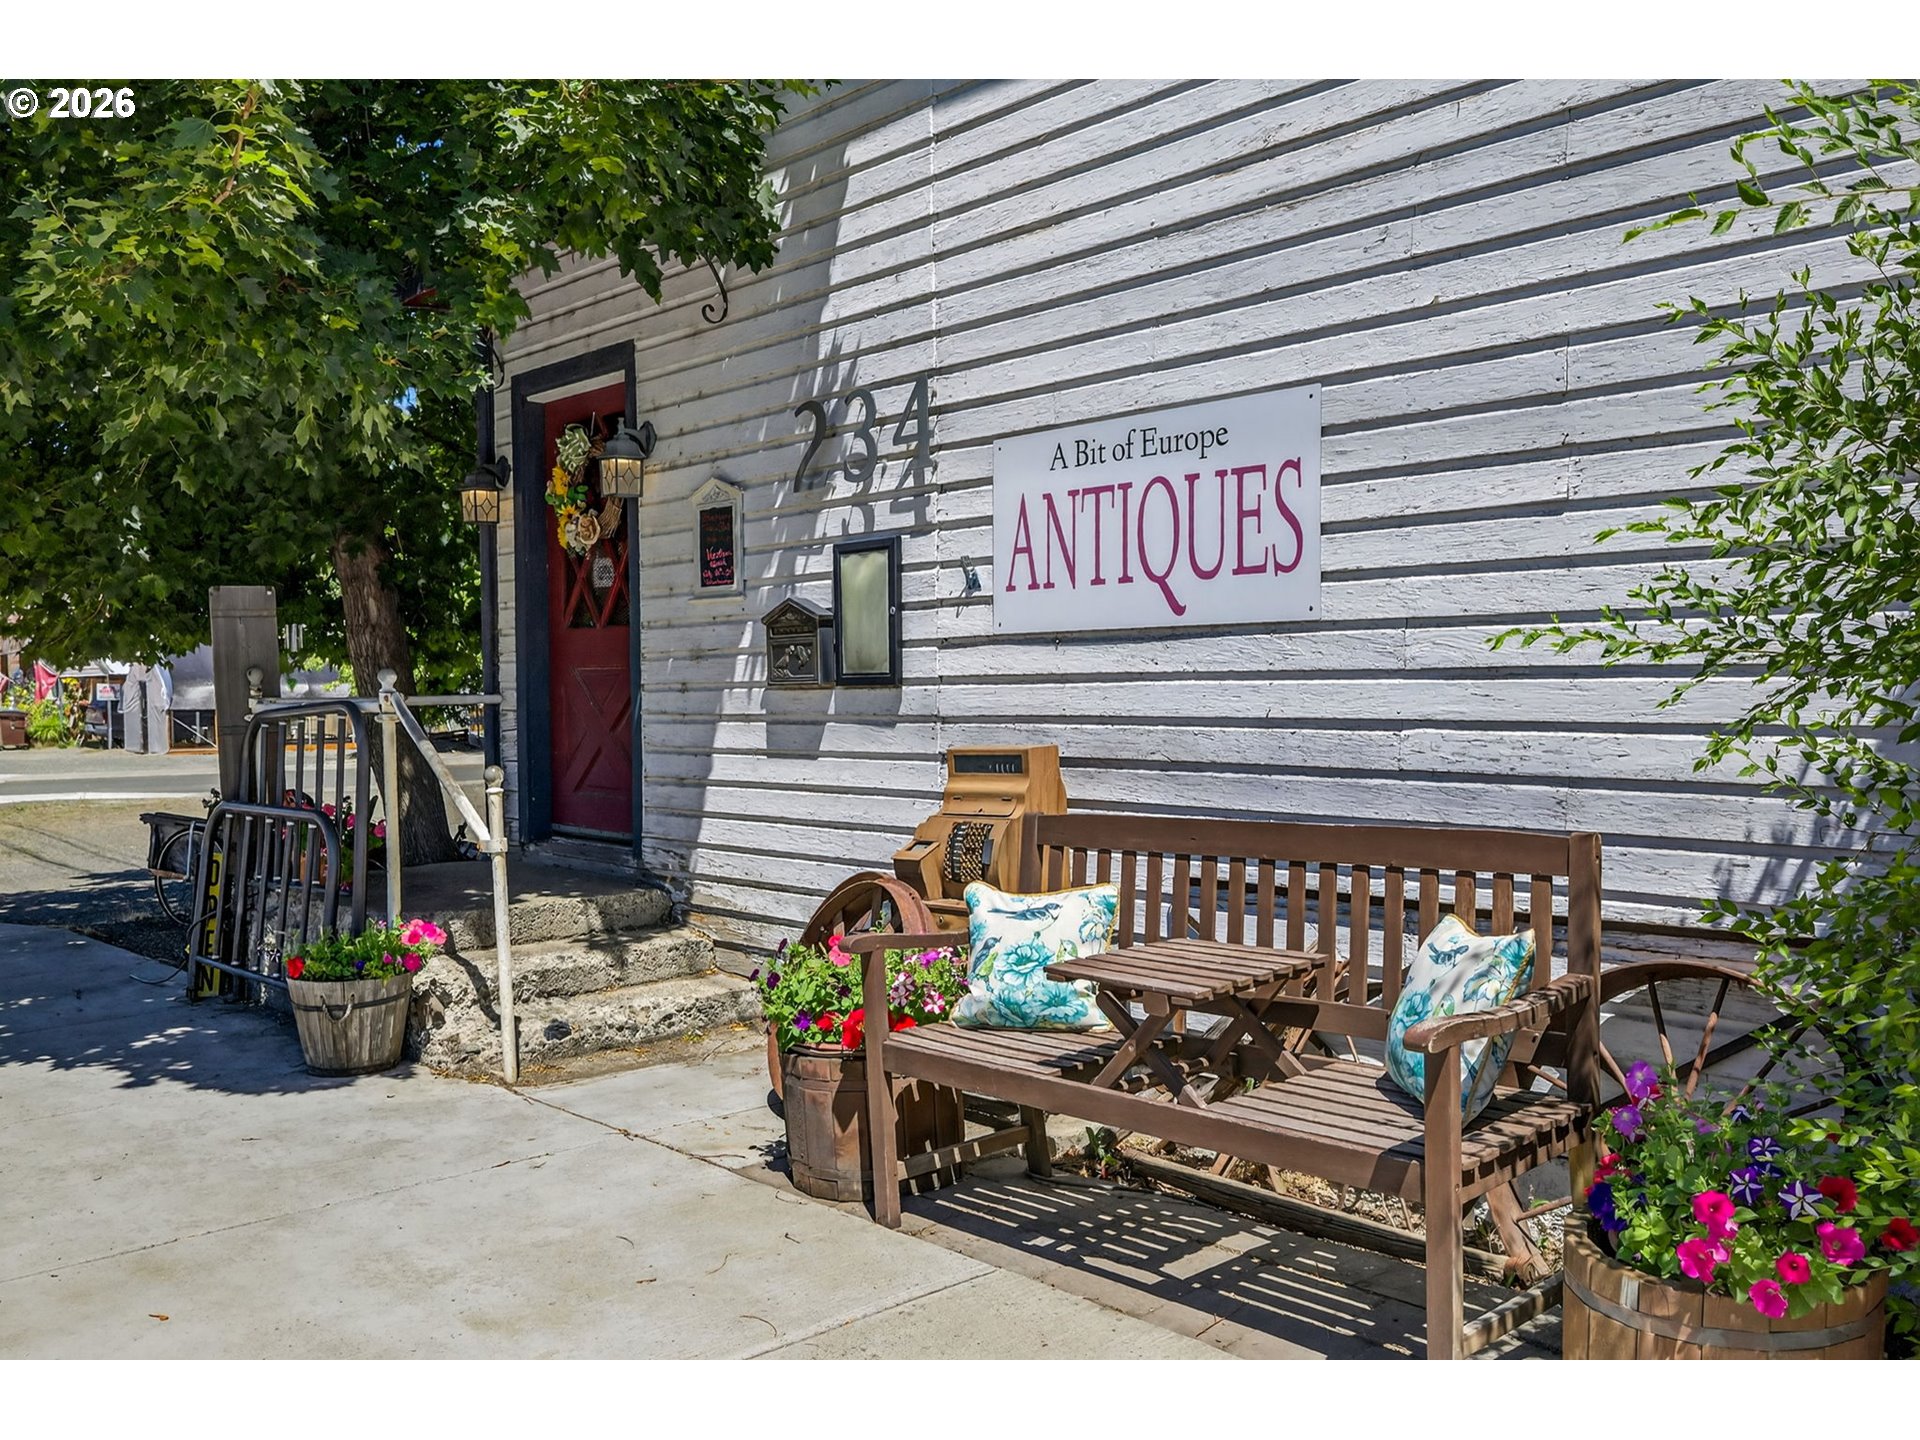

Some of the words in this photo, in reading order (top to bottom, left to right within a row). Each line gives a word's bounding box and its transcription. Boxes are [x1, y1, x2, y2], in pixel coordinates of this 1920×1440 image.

[793, 372, 935, 493] 234
[1049, 442, 1068, 471] A
[1074, 438, 1107, 469] Bit
[1112, 429, 1137, 461] of
[1140, 426, 1230, 460] Europe
[1005, 456, 1304, 617] ANTIQUES
